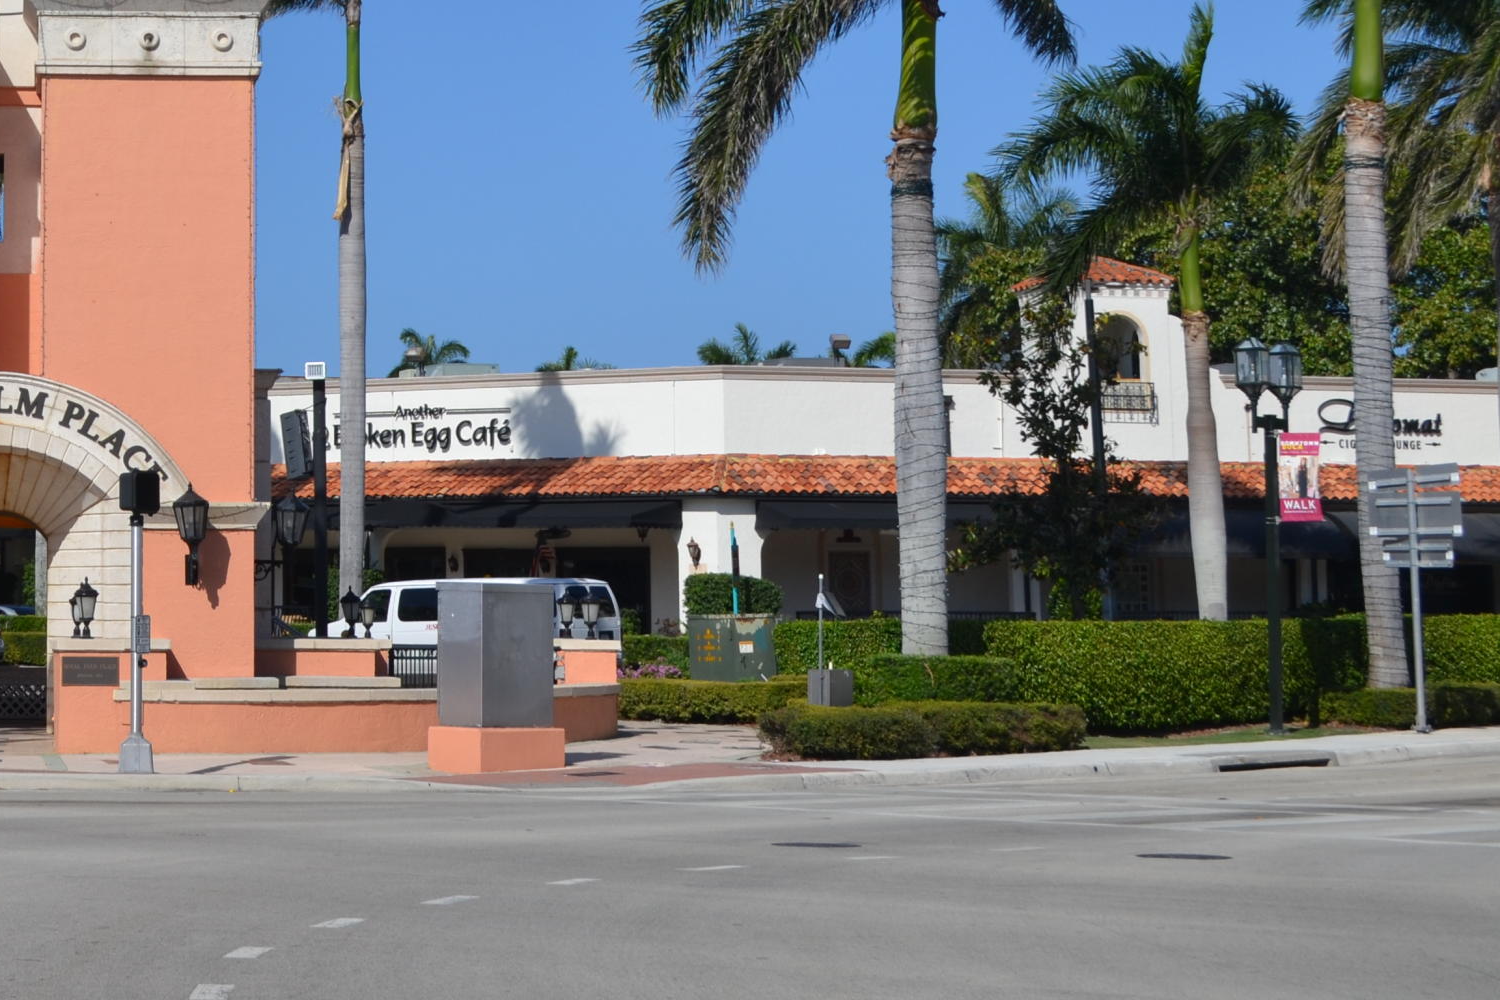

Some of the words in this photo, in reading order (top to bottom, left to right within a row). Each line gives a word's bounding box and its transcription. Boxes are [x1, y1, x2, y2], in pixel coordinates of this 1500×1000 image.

[395, 404, 446, 419] Another
[411, 422, 451, 451] Egg
[456, 418, 511, 448] Café
[1284, 500, 1316, 509] WALK
